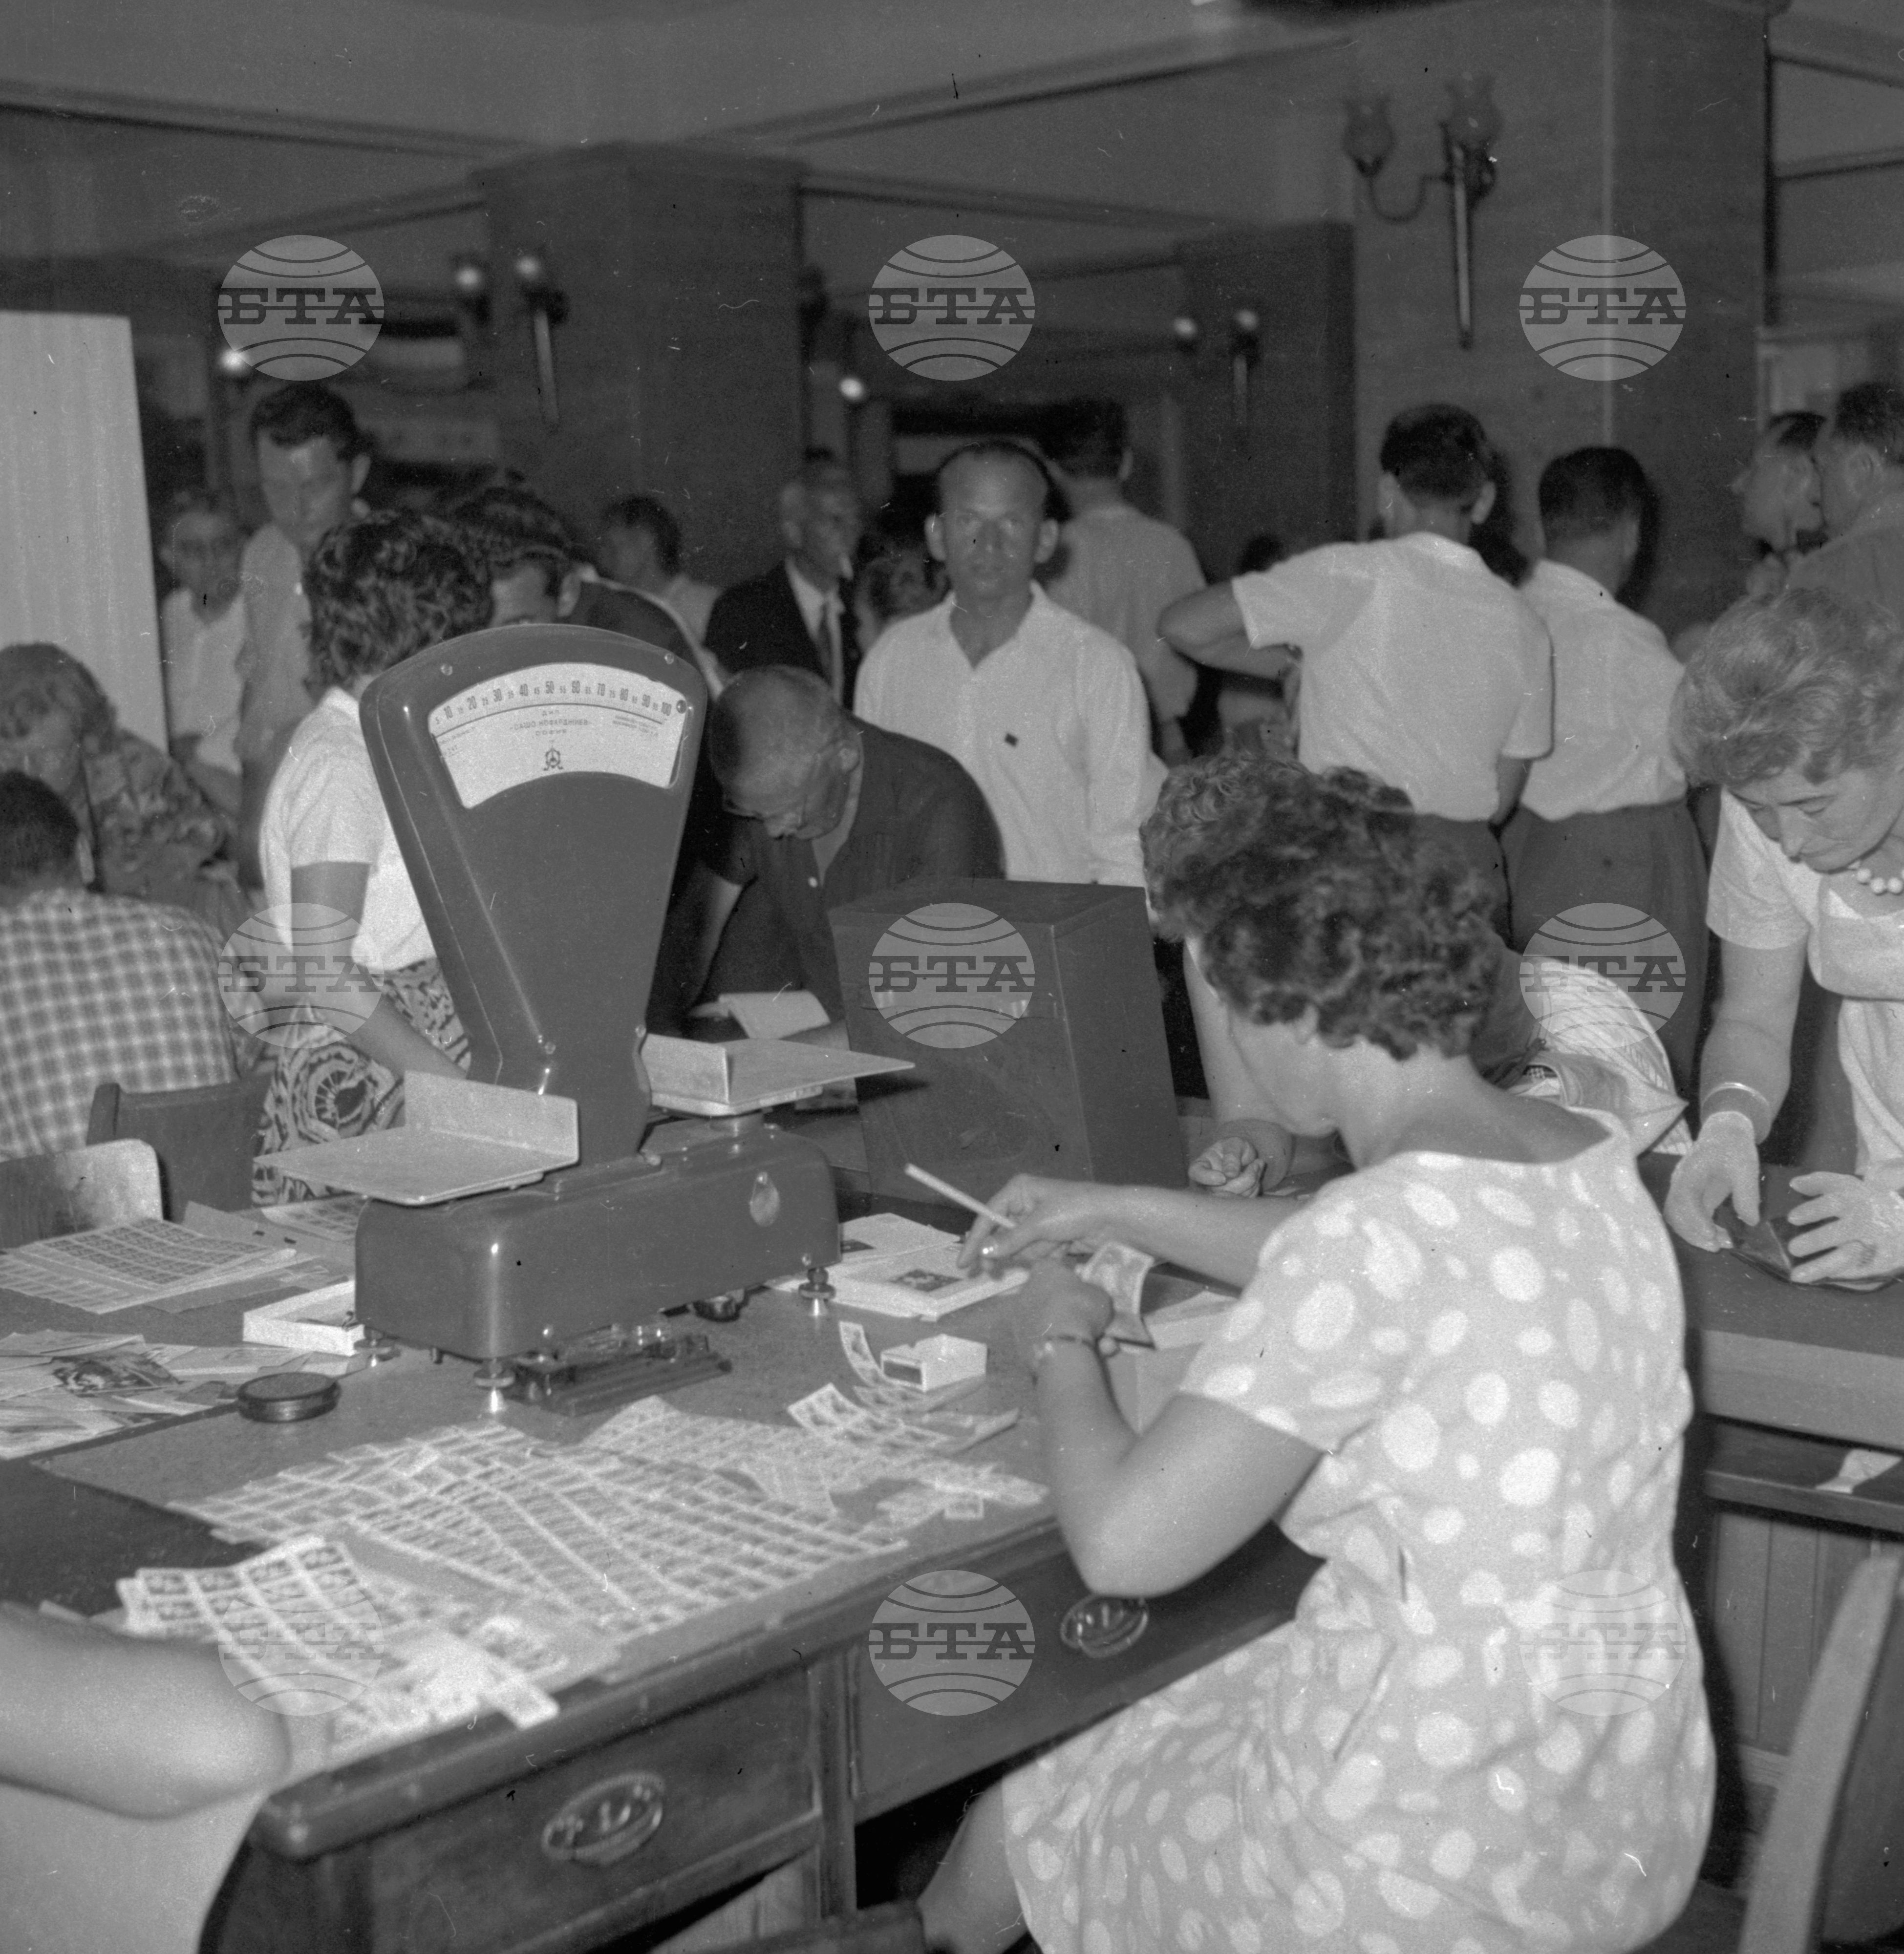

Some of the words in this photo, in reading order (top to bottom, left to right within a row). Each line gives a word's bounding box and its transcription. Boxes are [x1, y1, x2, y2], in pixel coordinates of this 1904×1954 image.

[444, 706, 453, 719] 10
[467, 696, 477, 710] 20
[493, 689, 502, 702] 30
[519, 684, 528, 696] 40
[545, 681, 555, 694] 50
[572, 681, 580, 694] 60
[597, 683, 605, 696] 70
[620, 688, 628, 701] 80
[642, 694, 651, 707] 90
[661, 702, 672, 716] 100
